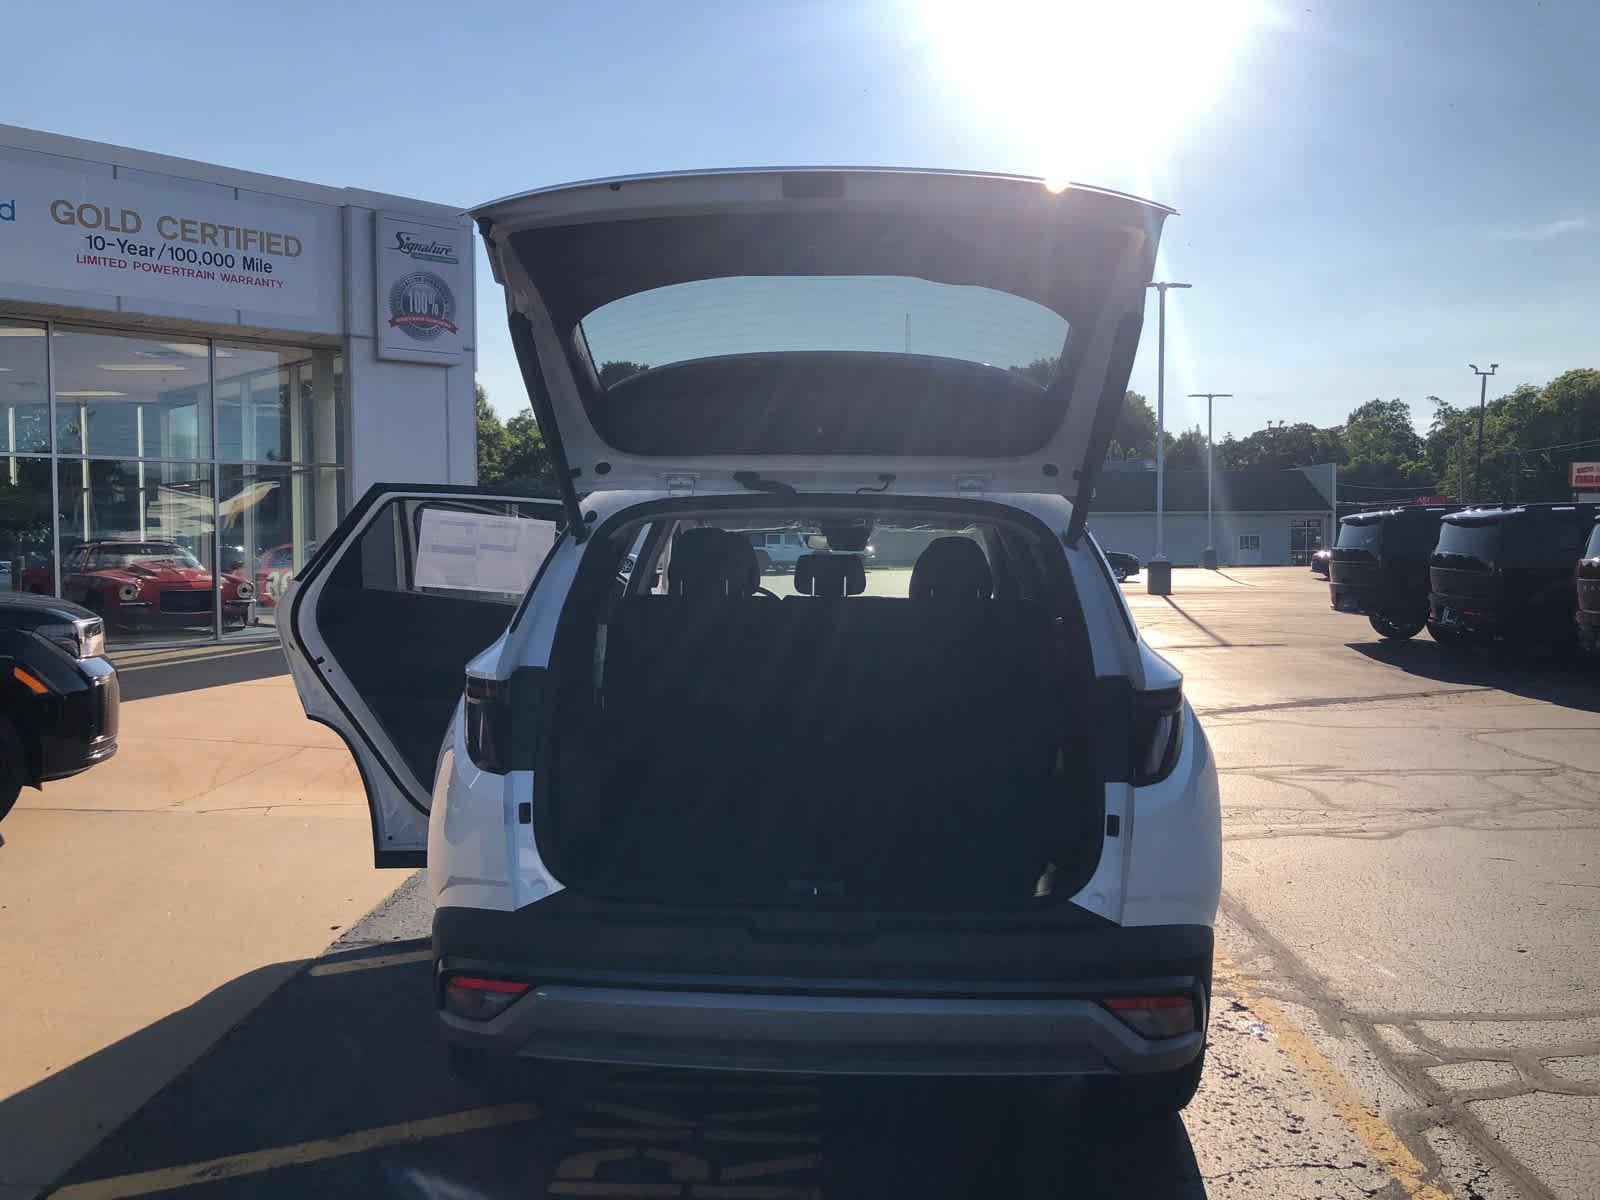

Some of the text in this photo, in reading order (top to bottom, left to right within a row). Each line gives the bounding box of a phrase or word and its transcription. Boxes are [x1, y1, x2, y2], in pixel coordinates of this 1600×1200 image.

[50, 199, 303, 257] GOLD CERTIFIED
[393, 231, 453, 256] Signature
[76, 254, 284, 289] LIMITED POWERTRAIN WARRANTY
[243, 255, 273, 273] Mile
[408, 290, 439, 315] 100%
